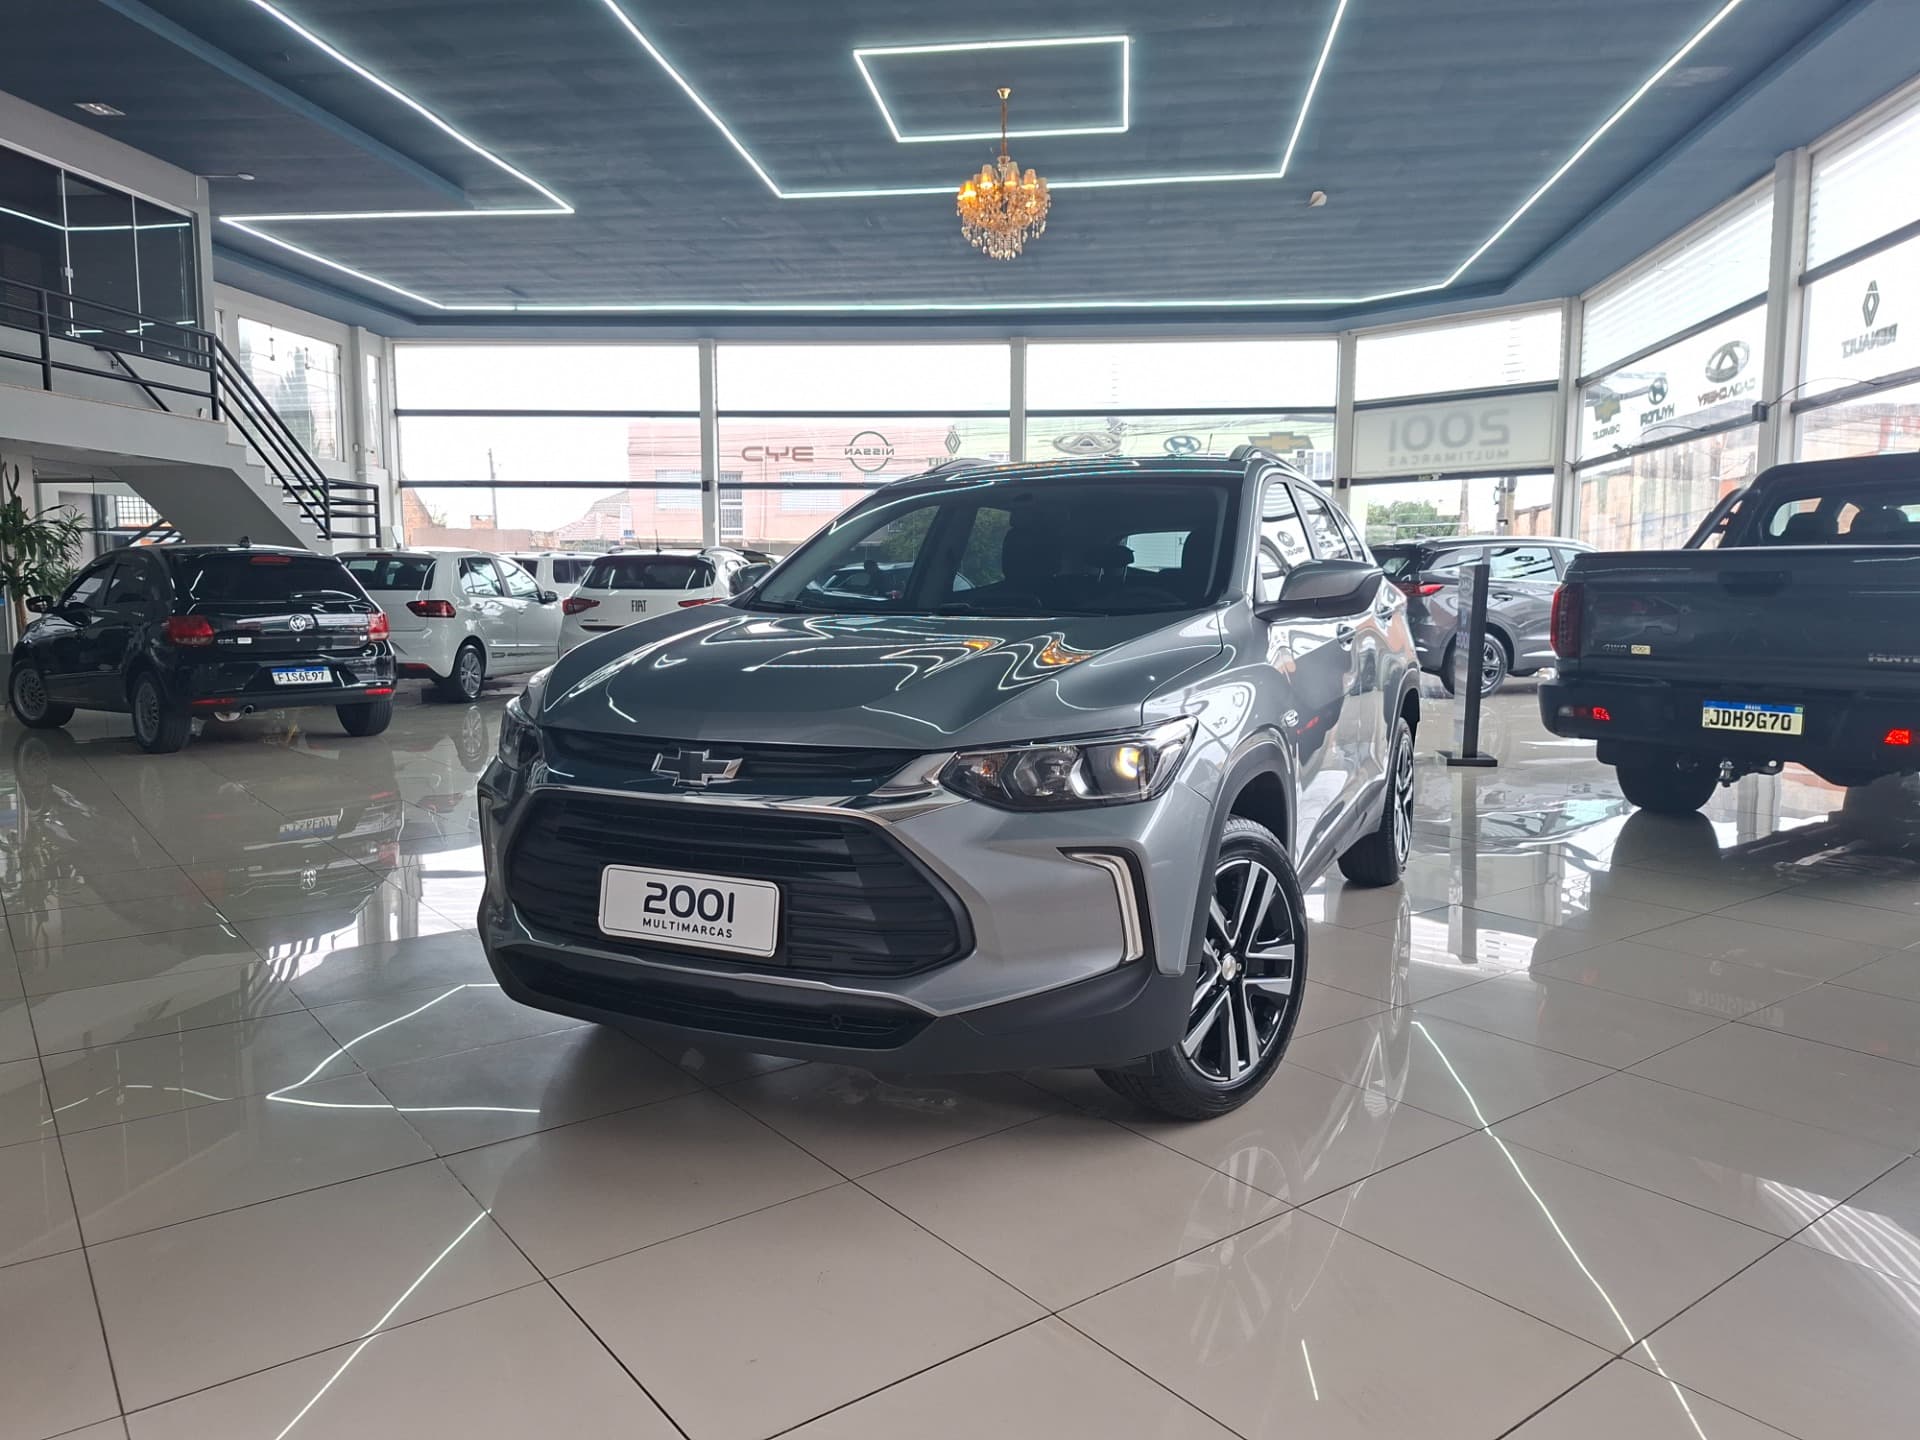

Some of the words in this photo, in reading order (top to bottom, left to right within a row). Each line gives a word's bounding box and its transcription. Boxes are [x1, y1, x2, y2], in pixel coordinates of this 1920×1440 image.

[631, 600, 648, 612] FIAT
[277, 671, 325, 682] FIS6E97
[1709, 709, 1792, 731] JDH9G70
[643, 881, 735, 924] 2001
[642, 917, 733, 938] MULTIMARCAS
